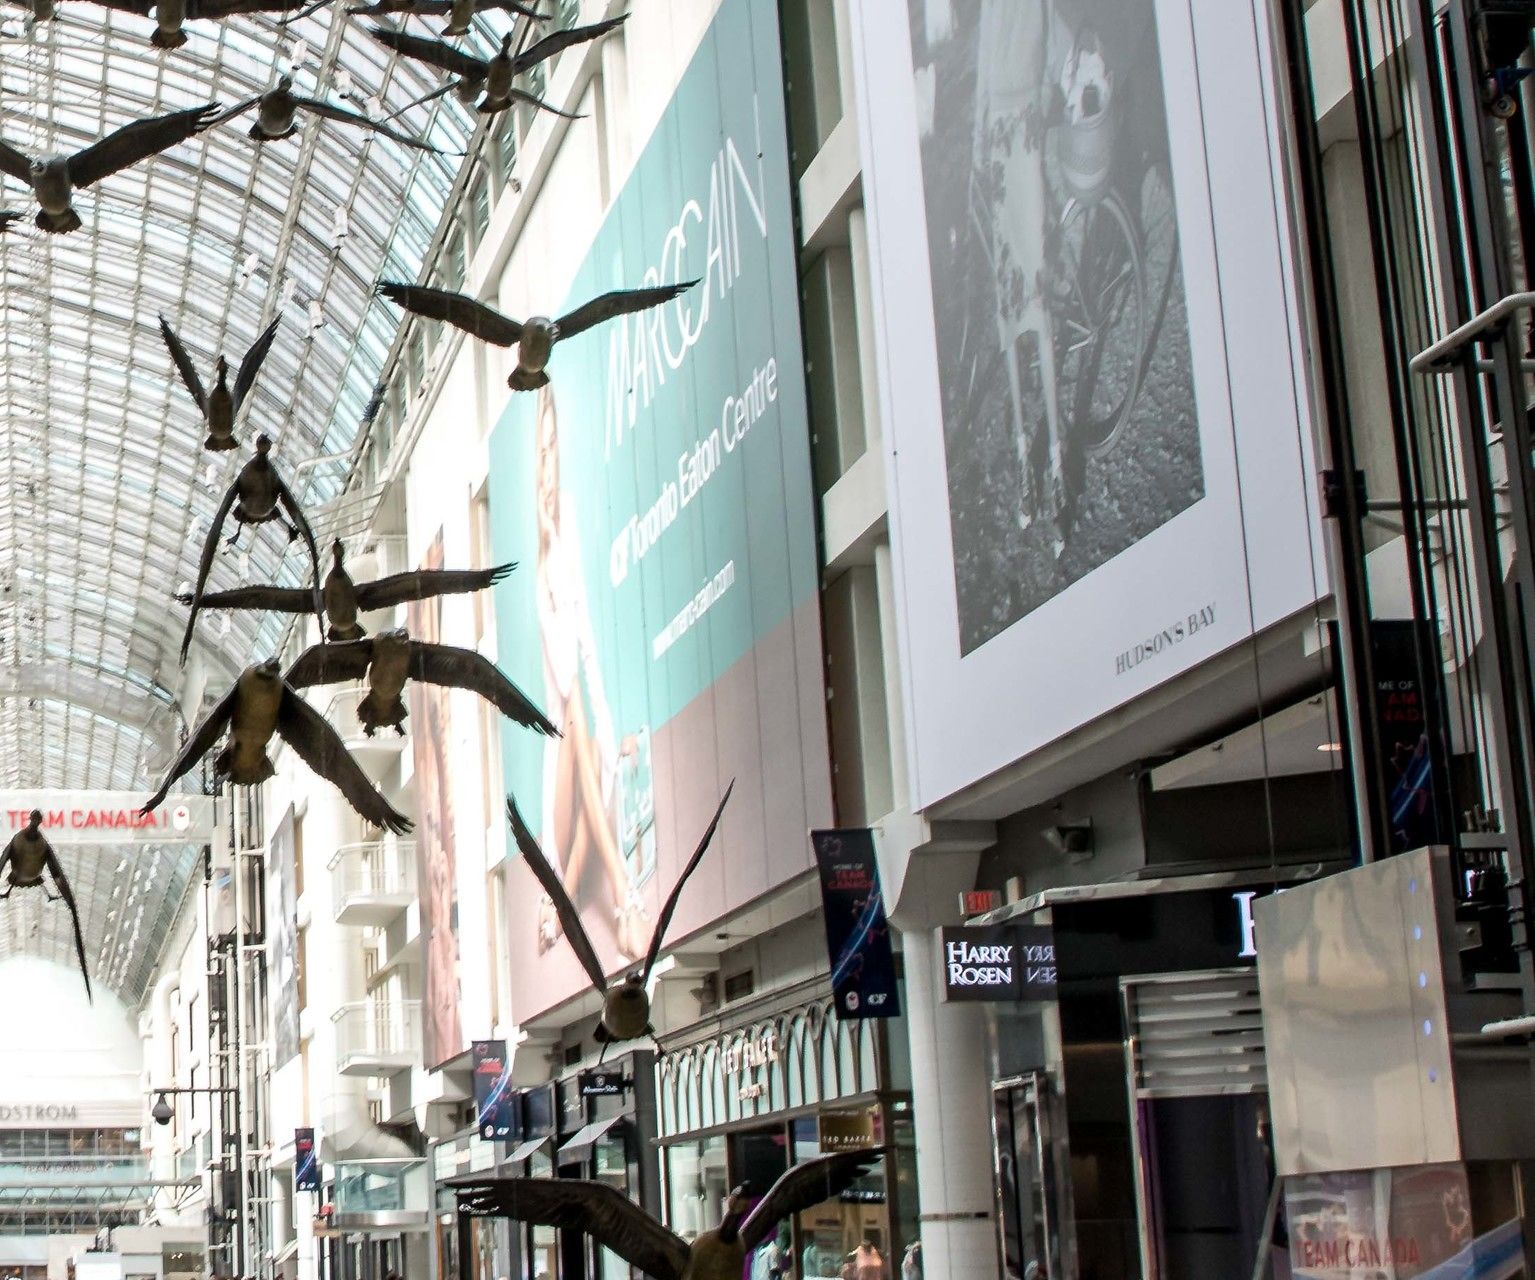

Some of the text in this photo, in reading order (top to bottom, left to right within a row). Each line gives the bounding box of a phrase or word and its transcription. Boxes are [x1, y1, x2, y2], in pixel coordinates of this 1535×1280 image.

[628, 481, 679, 564] Toronto
[678, 428, 720, 510] Eaton
[722, 357, 778, 454] Centre
[1187, 601, 1216, 636] BAY
[70, 809, 158, 830] CANADA
[967, 891, 993, 912] EXIT
[947, 941, 1013, 964] HARRY
[948, 964, 1013, 985] ROSEN
[1294, 1238, 1420, 1268] TEAM CANADA
